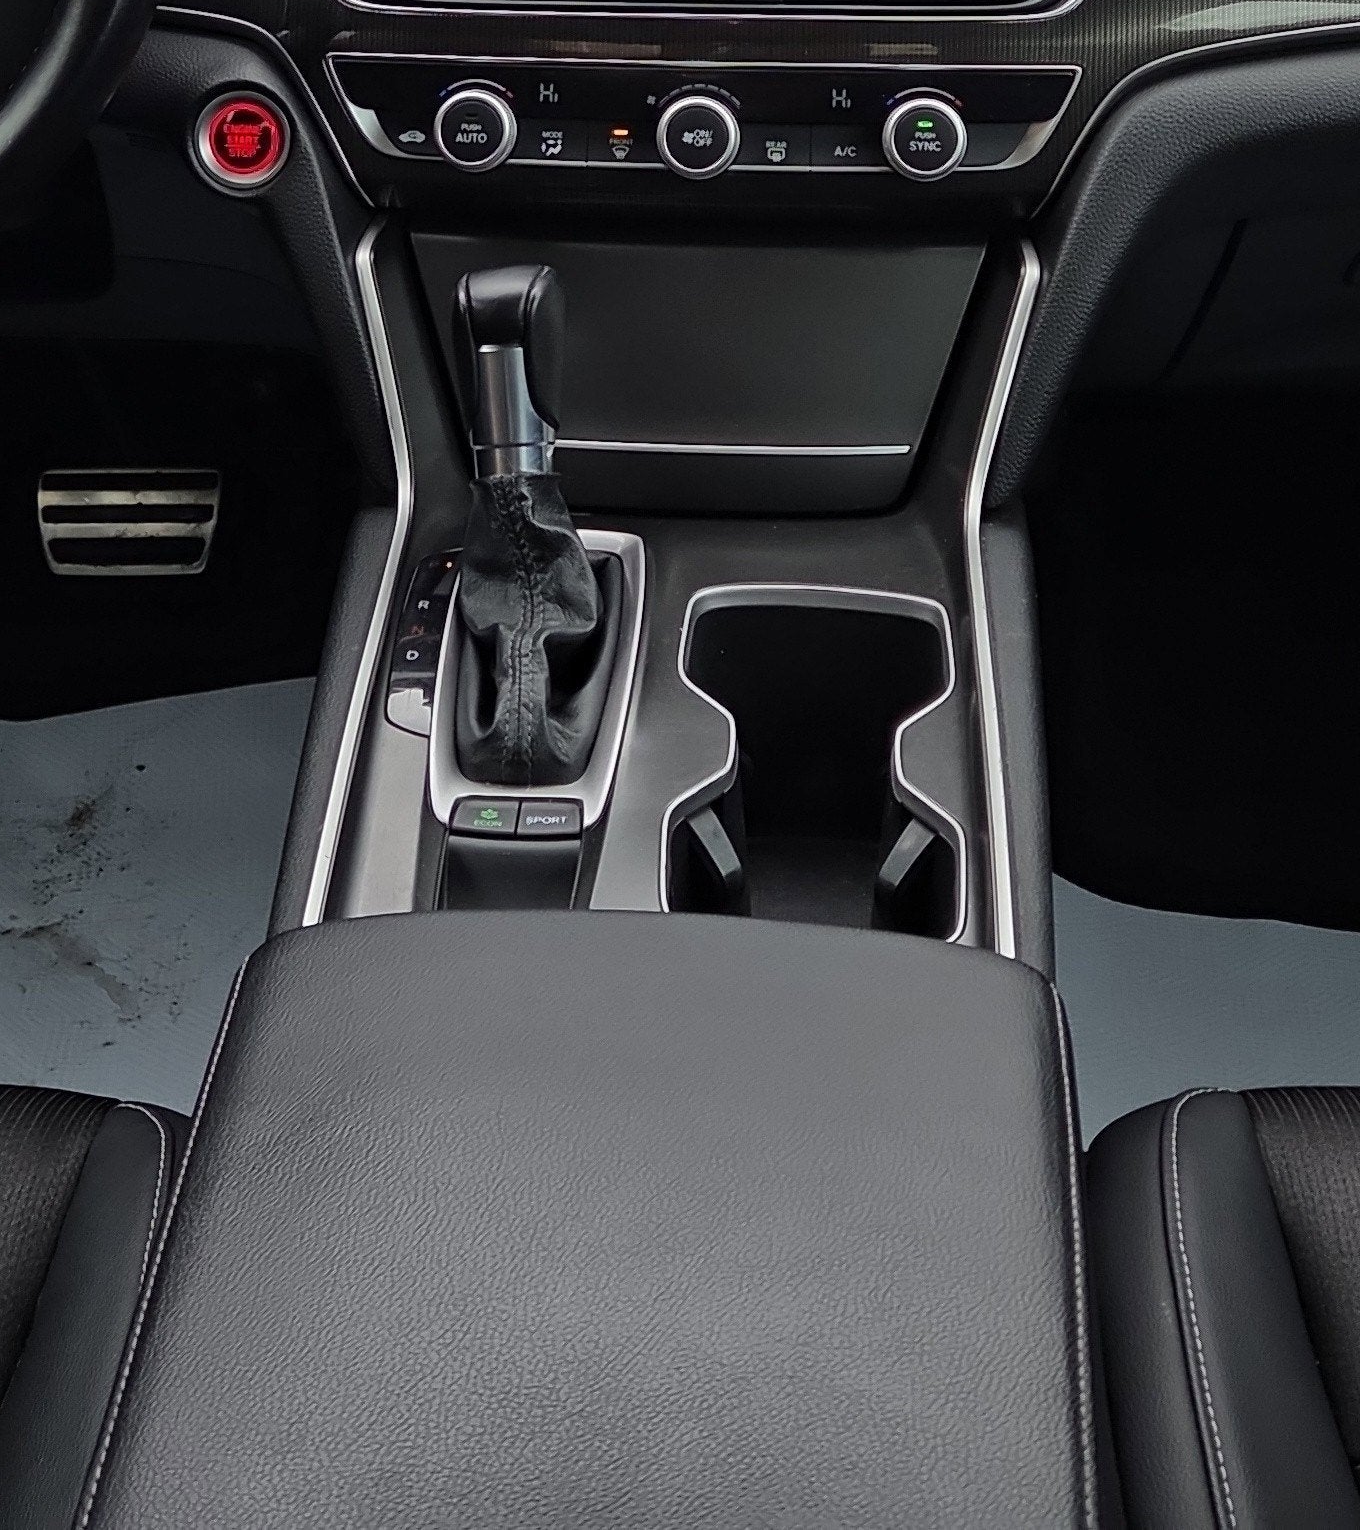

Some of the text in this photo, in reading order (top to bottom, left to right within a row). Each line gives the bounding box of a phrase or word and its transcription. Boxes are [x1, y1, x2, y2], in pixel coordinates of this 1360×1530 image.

[460, 123, 483, 132] PUSH
[455, 132, 488, 144] AUTO
[541, 130, 564, 139] MODE
[914, 131, 937, 140] PUSH
[608, 137, 634, 146] FRONT
[908, 140, 942, 152] SYNC
[834, 145, 858, 157] A/C
[525, 815, 568, 826] SPORT
